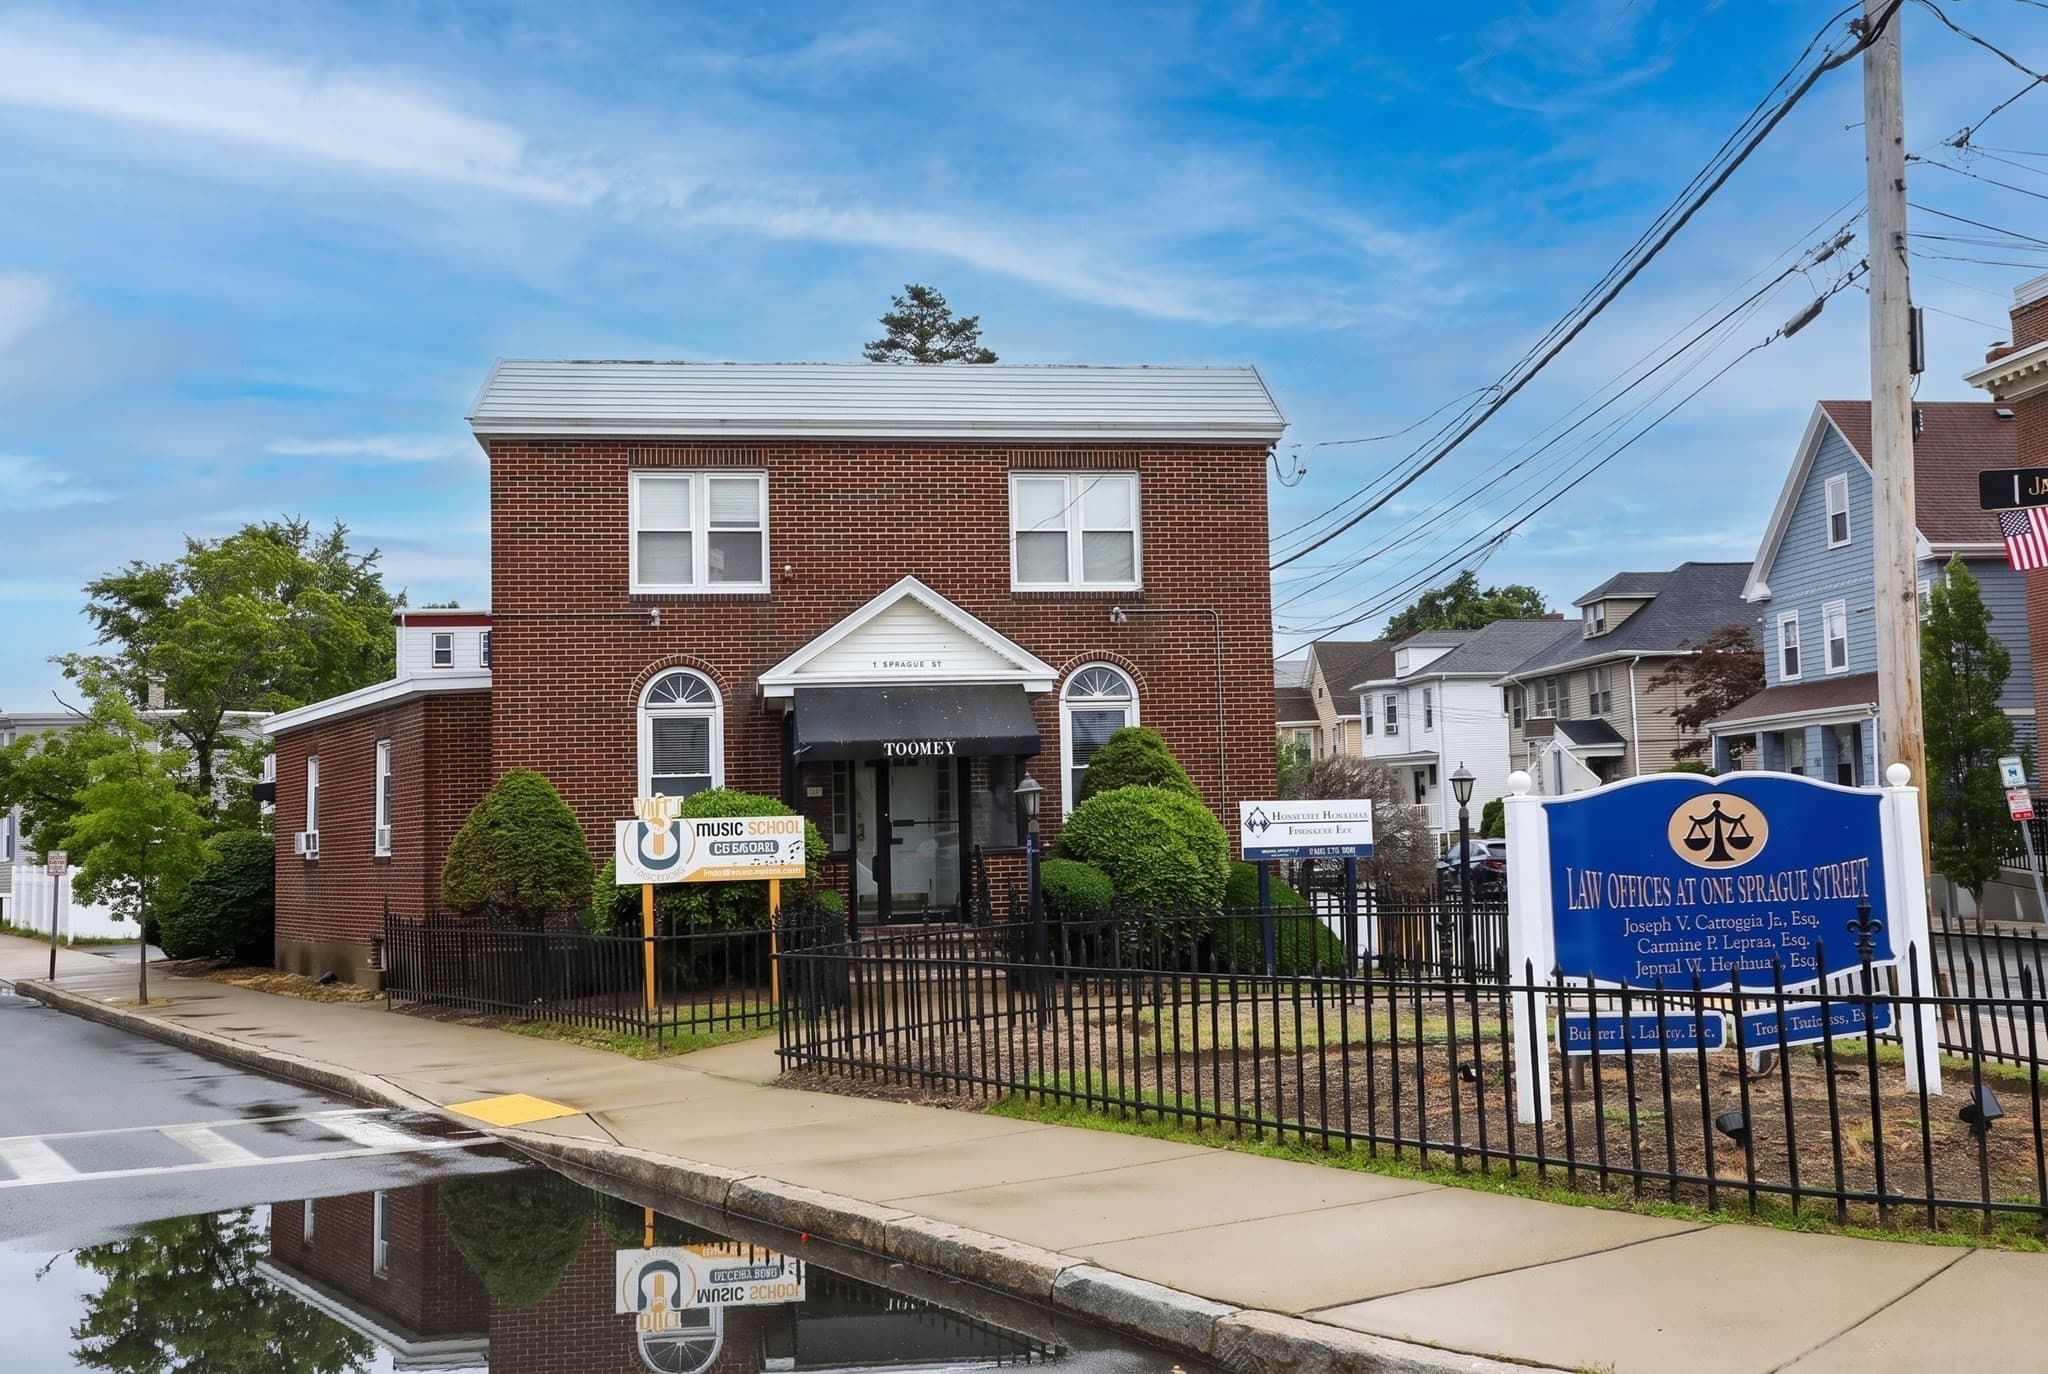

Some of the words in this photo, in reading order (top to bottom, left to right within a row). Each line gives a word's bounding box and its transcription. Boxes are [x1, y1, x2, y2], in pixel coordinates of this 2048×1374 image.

[882, 660, 925, 669] SPRAGUE
[931, 660, 942, 669] ST
[883, 741, 956, 757] TOOMEY
[696, 822, 744, 837] MUSIC
[748, 819, 802, 835] SCHOOL
[1566, 867, 1602, 910] LAW
[1607, 873, 1671, 909] OFFICES
[1675, 877, 1697, 906] AT
[1700, 877, 1734, 905] ONE
[1737, 869, 1809, 904] SPRAGUE
[1812, 857, 1869, 900] STREET
[1624, 916, 1672, 936] Joseph
[1676, 915, 1691, 931] V.
[1791, 910, 1820, 928] Esq.
[1637, 938, 1702, 954] Carmine
[1706, 935, 1718, 951] P.
[1781, 932, 1810, 950] Esq.
[1685, 957, 1706, 973] W.
[1789, 952, 1819, 970] Esq.
